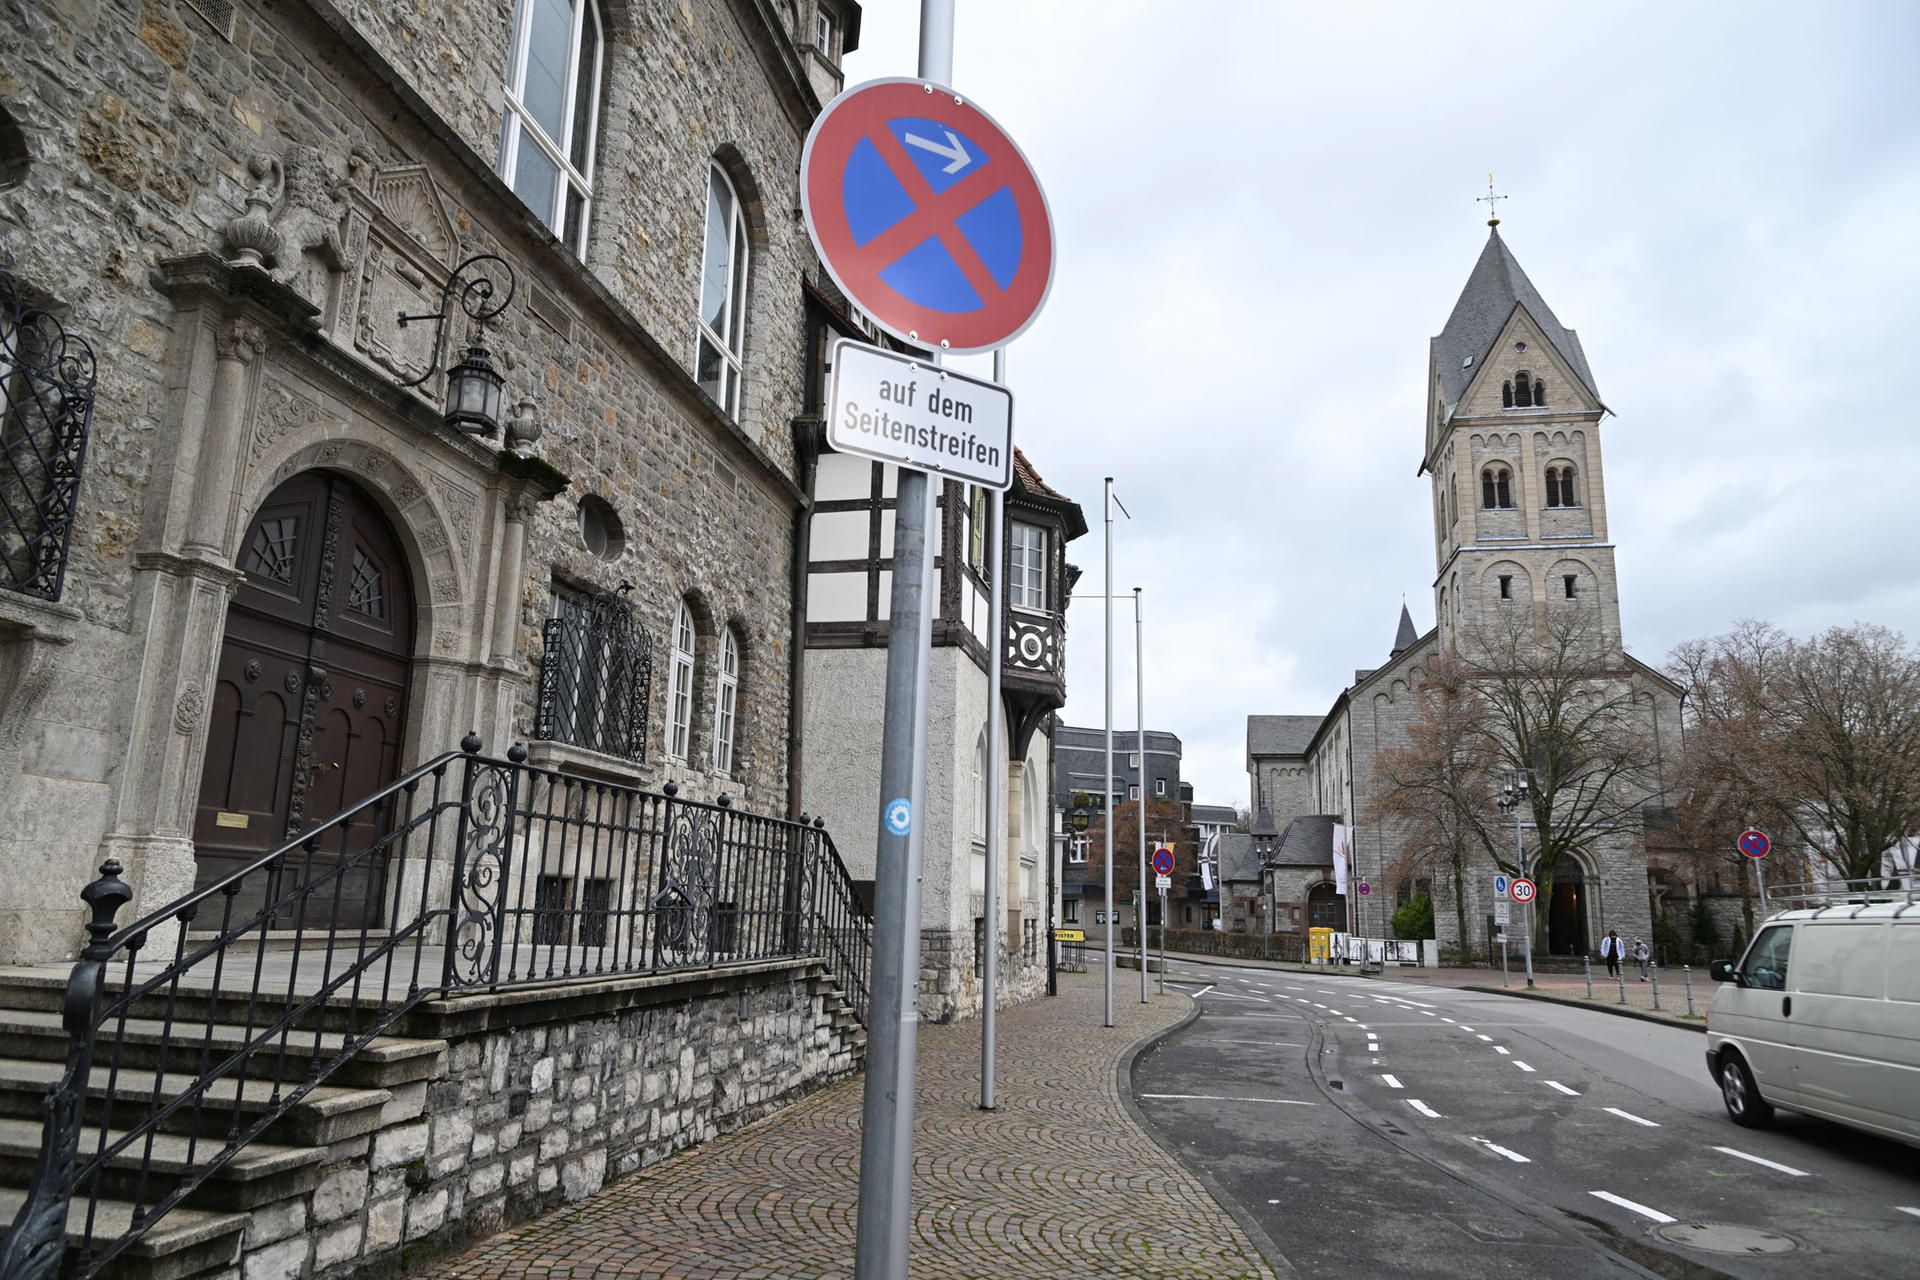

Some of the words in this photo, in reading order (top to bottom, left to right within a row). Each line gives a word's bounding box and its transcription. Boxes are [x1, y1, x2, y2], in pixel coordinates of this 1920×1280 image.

[879, 379, 917, 407] auf
[928, 388, 973, 423] dem
[844, 401, 1000, 468] Seitenstreifen
[1516, 885, 1530, 896] 30
